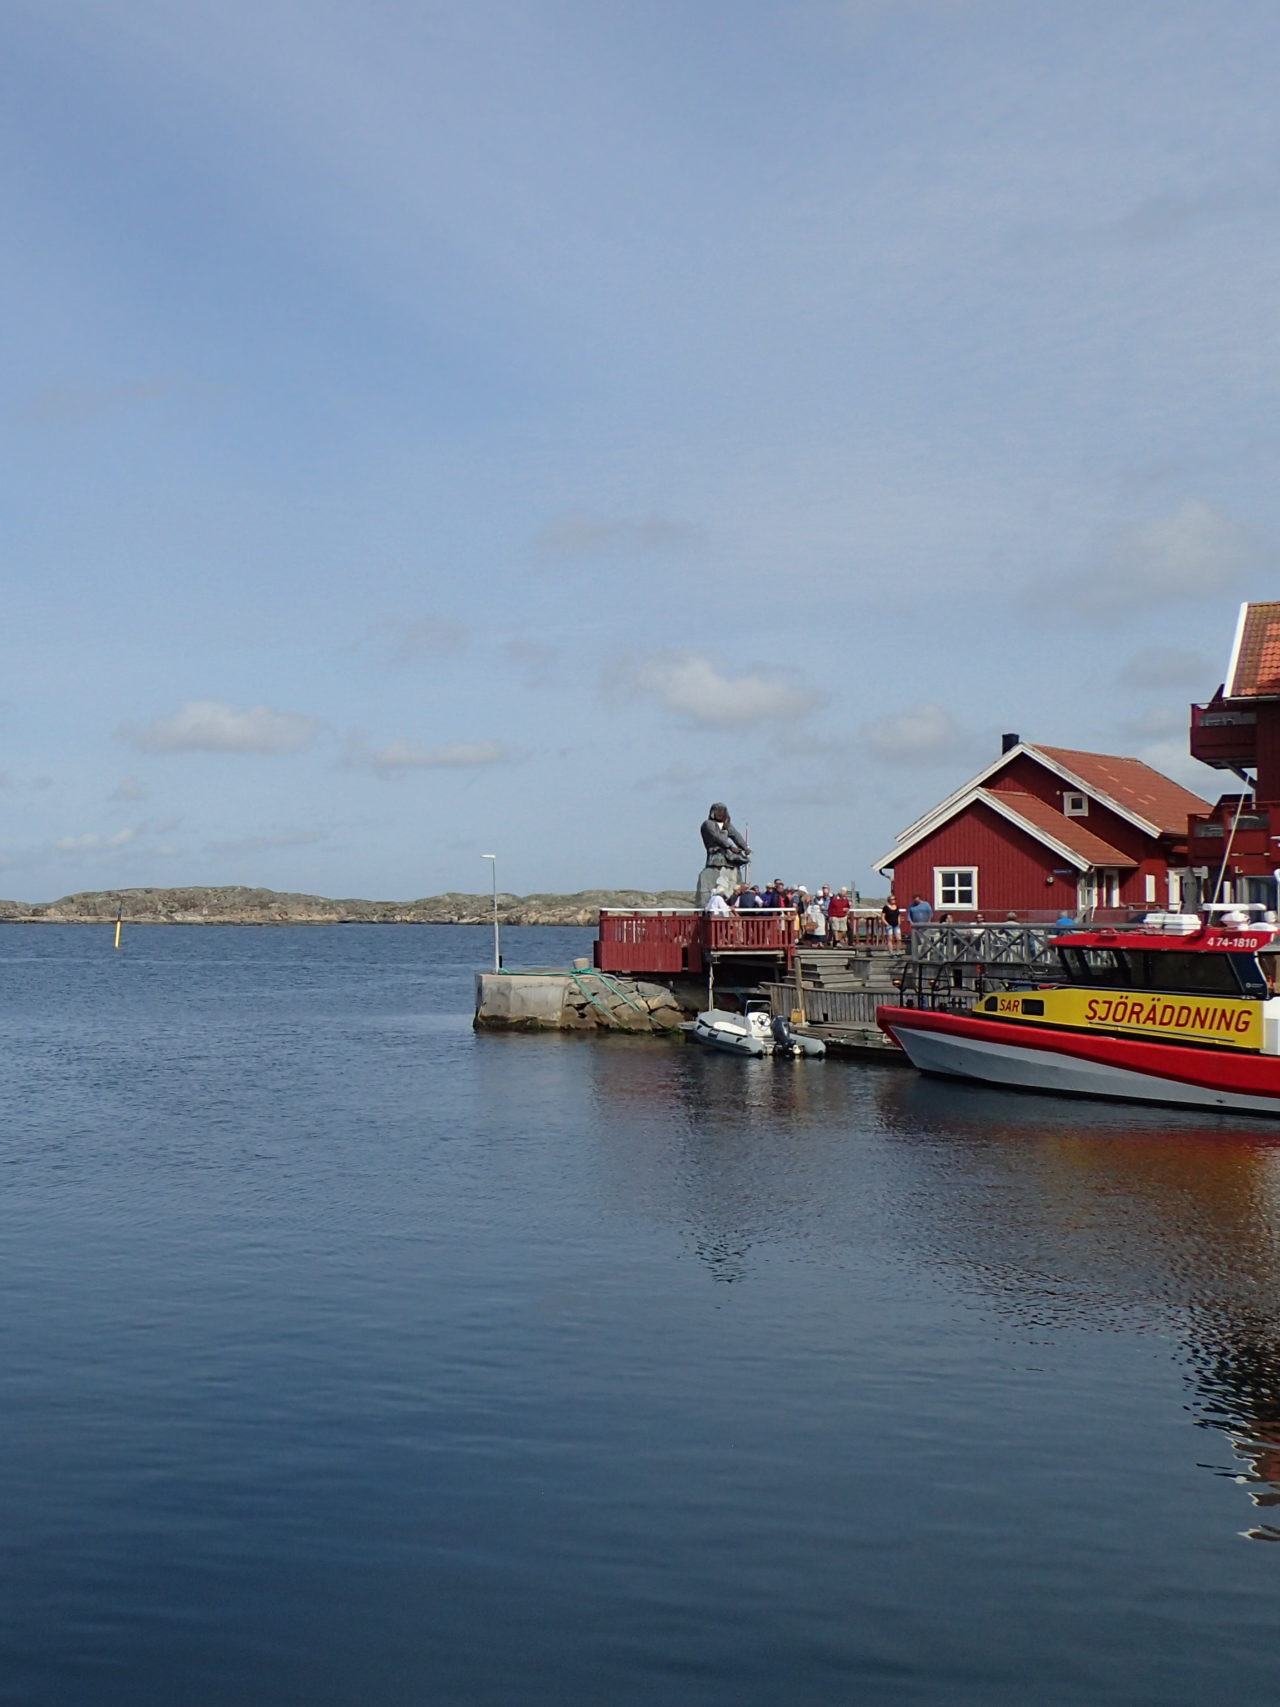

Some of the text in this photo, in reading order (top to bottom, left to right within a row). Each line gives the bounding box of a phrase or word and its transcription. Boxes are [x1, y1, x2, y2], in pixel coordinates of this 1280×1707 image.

[1207, 937, 1258, 948] 4 74-1810
[1000, 999, 1020, 1013] SAR
[1085, 995, 1253, 1033] SJÖRÄDDNING
